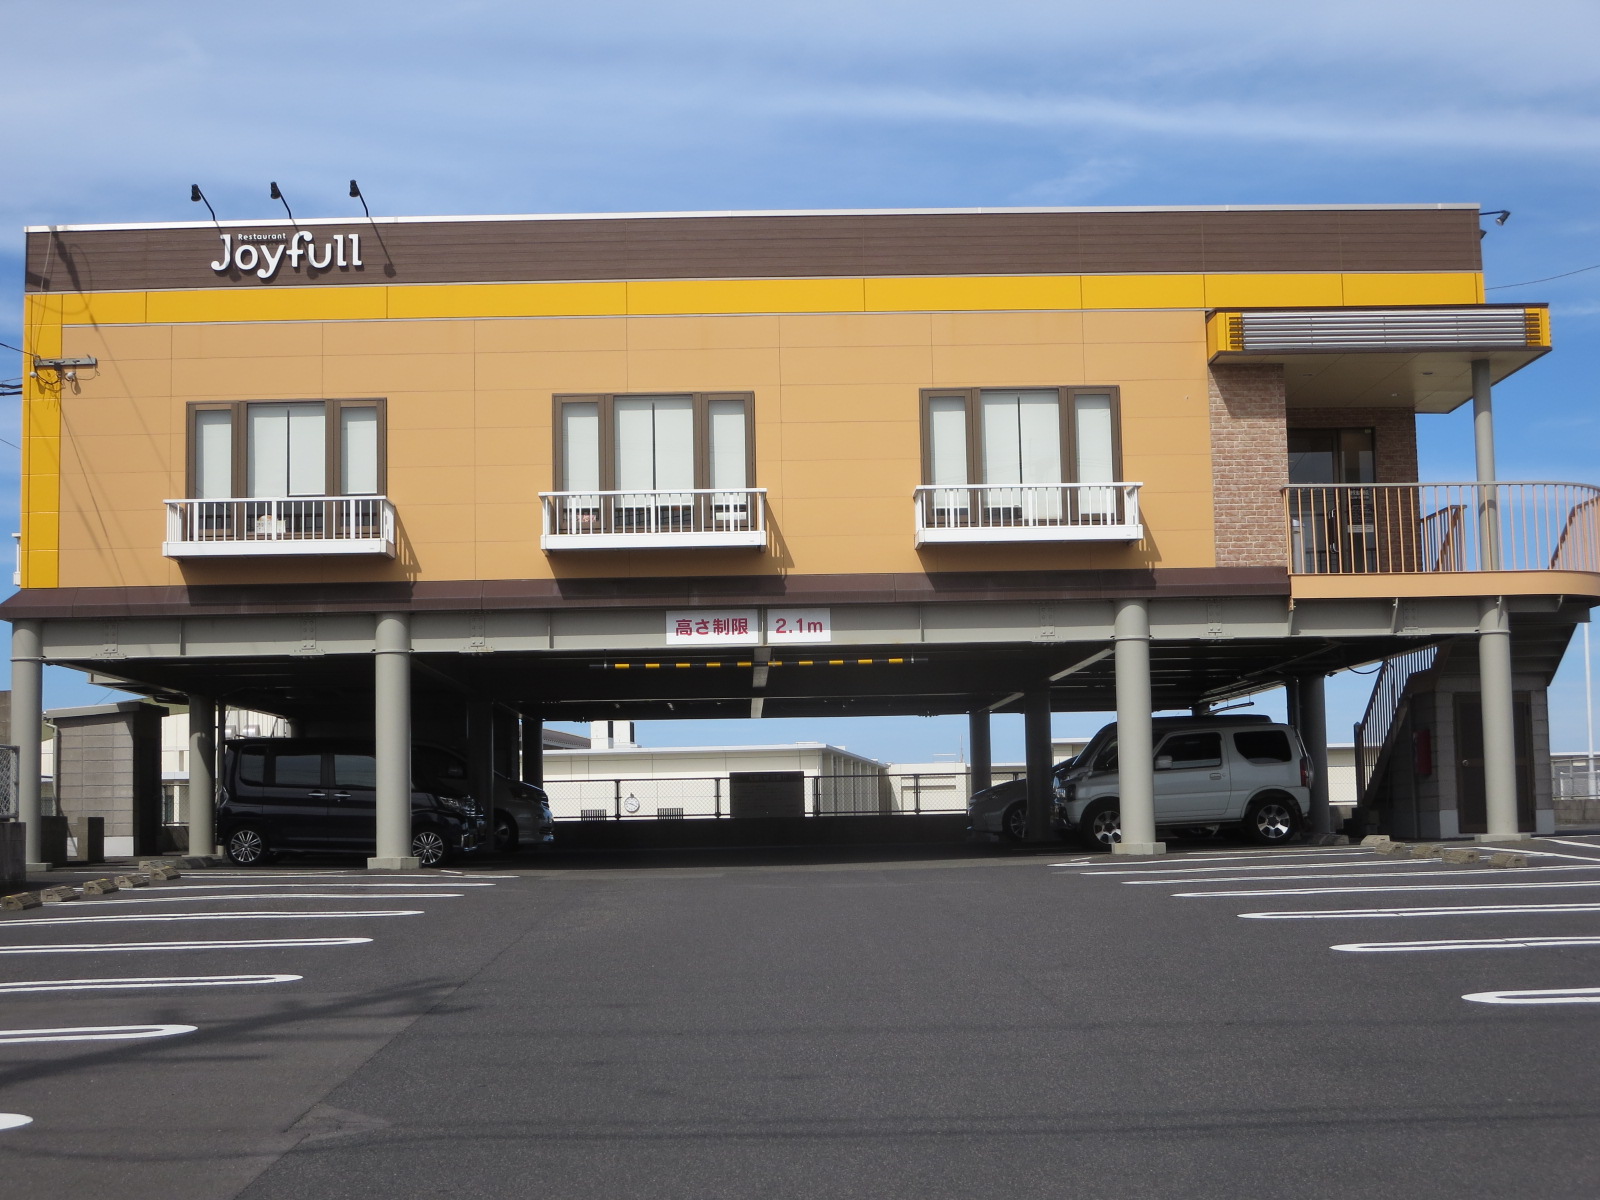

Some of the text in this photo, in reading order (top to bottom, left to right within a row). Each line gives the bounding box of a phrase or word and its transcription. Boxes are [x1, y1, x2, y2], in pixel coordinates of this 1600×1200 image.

[238, 232, 286, 241] Restaurant
[210, 230, 363, 279] Joyfull
[675, 617, 749, 636] 高さ制限
[775, 617, 823, 634] 2.1m
